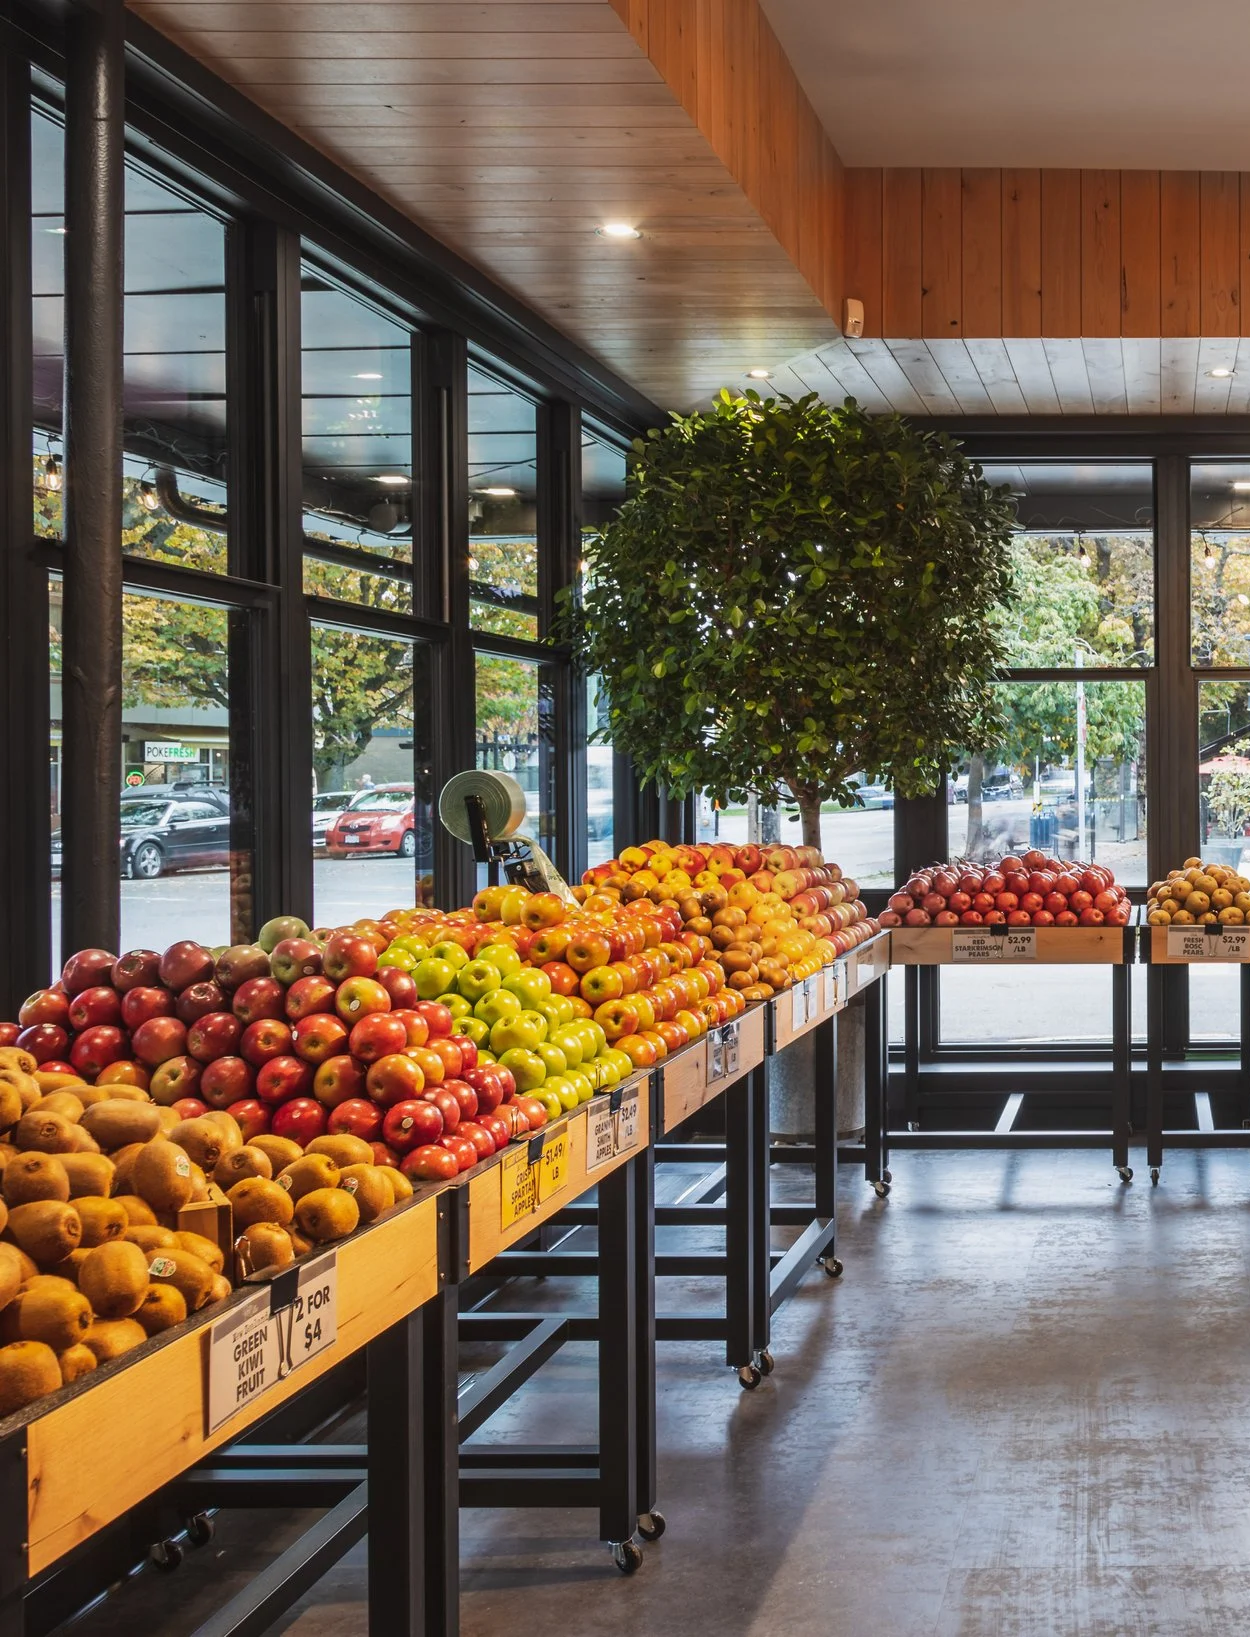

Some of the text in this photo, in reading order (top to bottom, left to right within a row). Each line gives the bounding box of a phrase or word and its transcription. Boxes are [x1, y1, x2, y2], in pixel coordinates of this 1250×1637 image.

[1007, 936, 1031, 944] $2.99
[1222, 935, 1246, 944] $2.99
[622, 1104, 637, 1122] $2.49
[596, 1144, 612, 1160] APPLES
[516, 1167, 531, 1186] CRISP
[552, 1167, 559, 1180] LB
[295, 1285, 330, 1323] 2 FOR
[234, 1326, 268, 1362] GREEN
[304, 1318, 321, 1351] $4
[238, 1349, 263, 1380] KIWI
[236, 1368, 265, 1402] FRUIT
